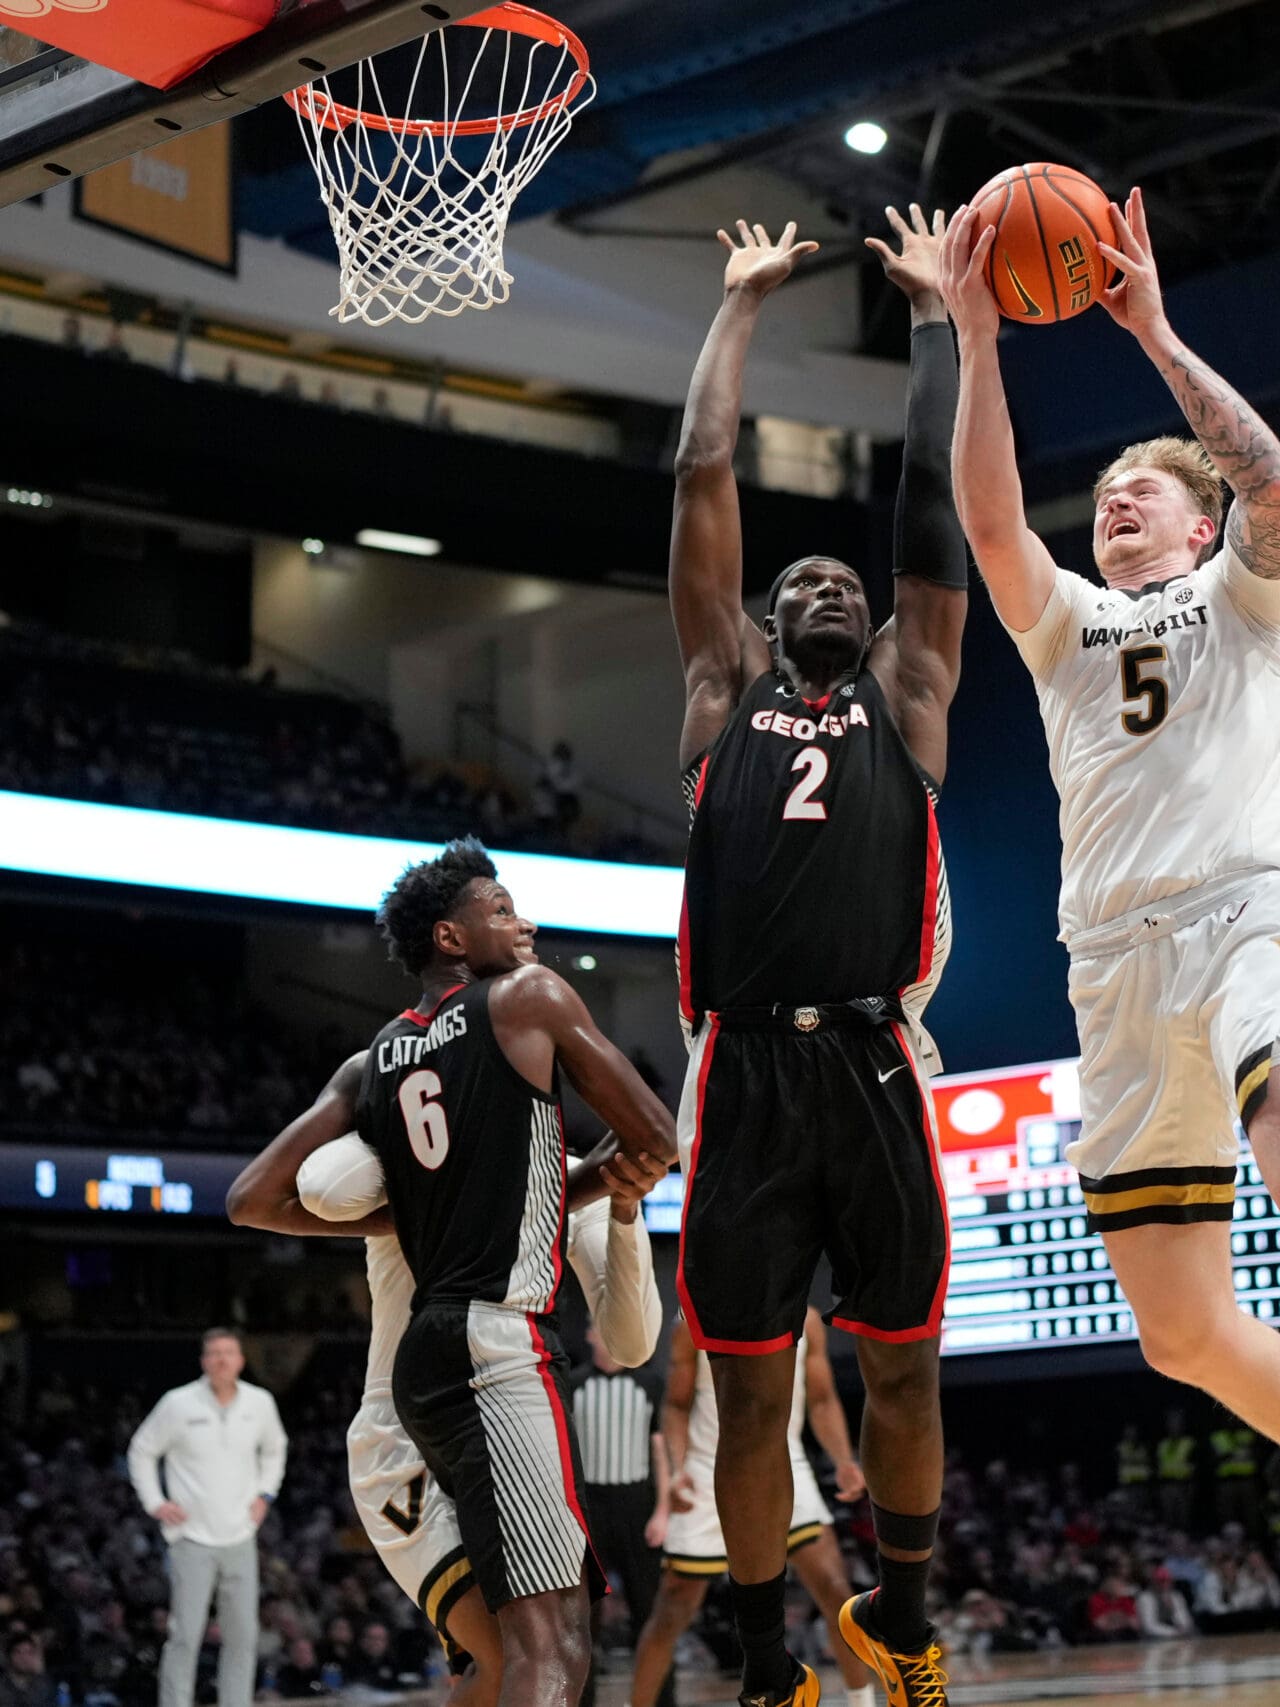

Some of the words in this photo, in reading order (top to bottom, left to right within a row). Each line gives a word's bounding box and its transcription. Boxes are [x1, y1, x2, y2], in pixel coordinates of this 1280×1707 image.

[1057, 234, 1092, 311] ELITE
[1082, 605, 1208, 649] VANBILT
[1120, 643, 1169, 737] 5
[782, 745, 829, 821] 2
[398, 1068, 450, 1171] 6
